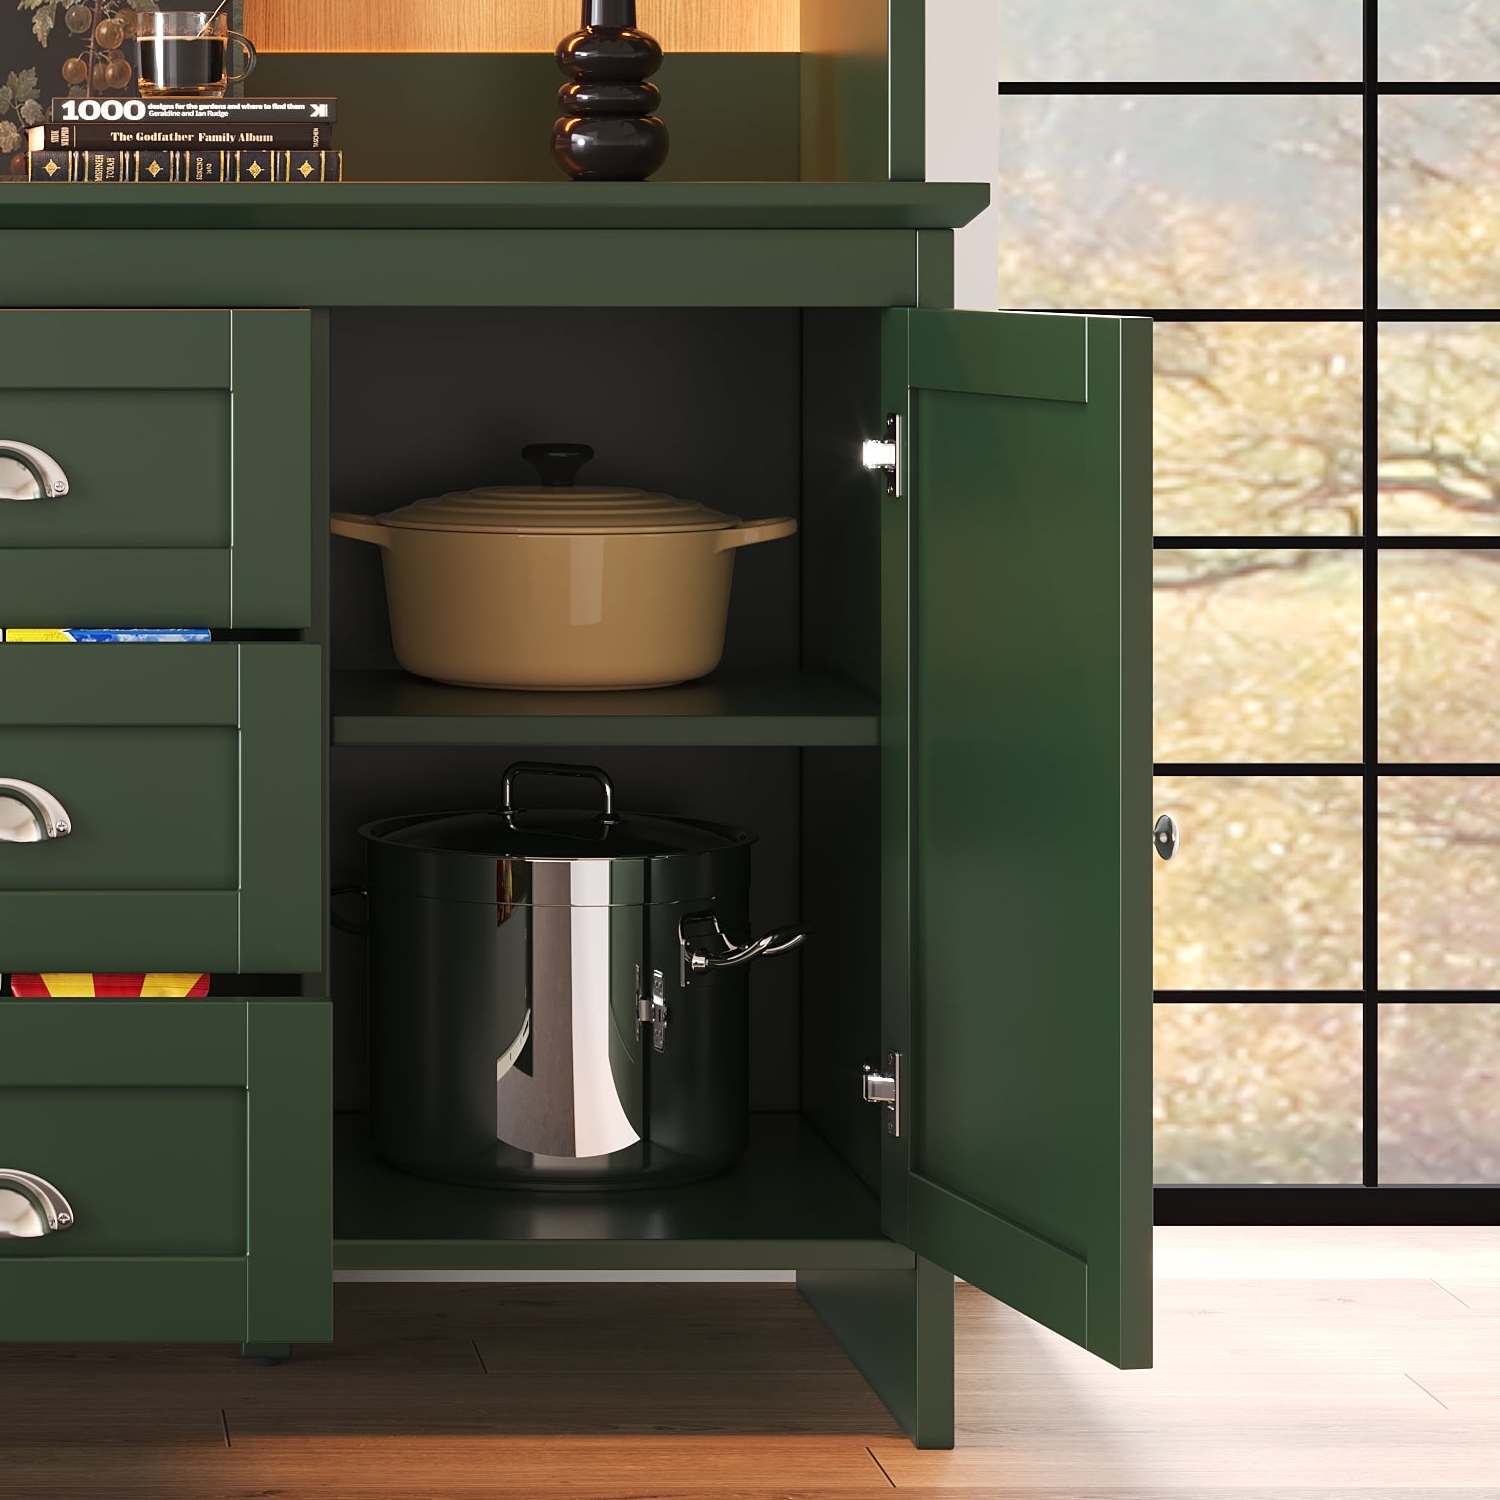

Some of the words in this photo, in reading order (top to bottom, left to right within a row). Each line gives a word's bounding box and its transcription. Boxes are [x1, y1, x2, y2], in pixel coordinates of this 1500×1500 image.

[62, 100, 146, 121] 1000
[147, 103, 175, 111] designs
[199, 103, 226, 111] gardens
[207, 110, 229, 118] Rudge
[111, 132, 133, 141] The
[136, 132, 194, 141] Godfather
[198, 132, 236, 143] Family
[238, 132, 273, 142] Album
[106, 157, 115, 179] TORAH
